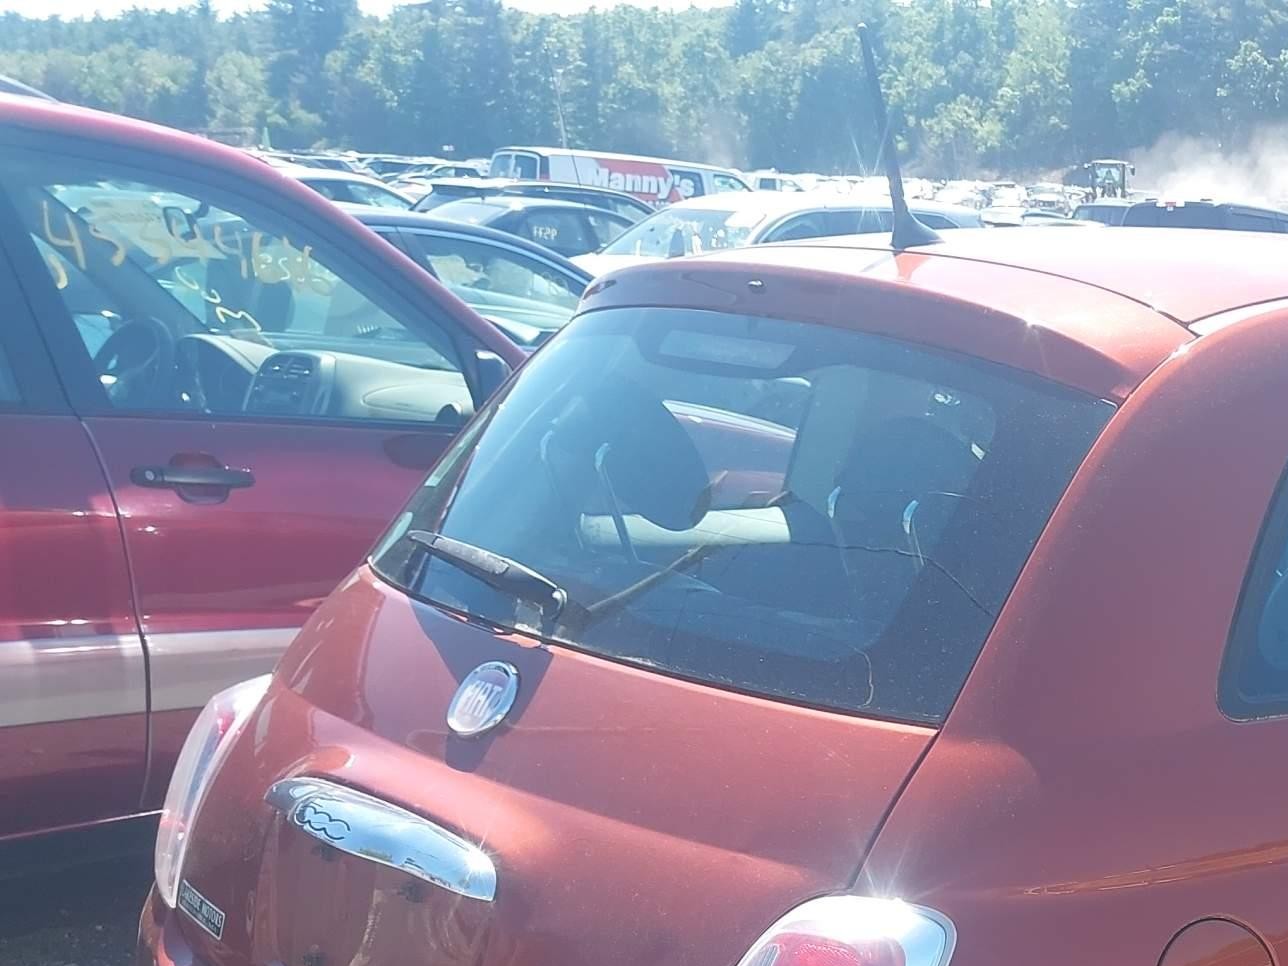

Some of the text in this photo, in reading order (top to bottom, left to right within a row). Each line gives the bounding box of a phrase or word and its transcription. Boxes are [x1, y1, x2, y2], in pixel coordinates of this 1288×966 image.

[590, 167, 695, 199] Manny's
[297, 803, 350, 840] 500
[201, 902, 222, 928] MOTORS
